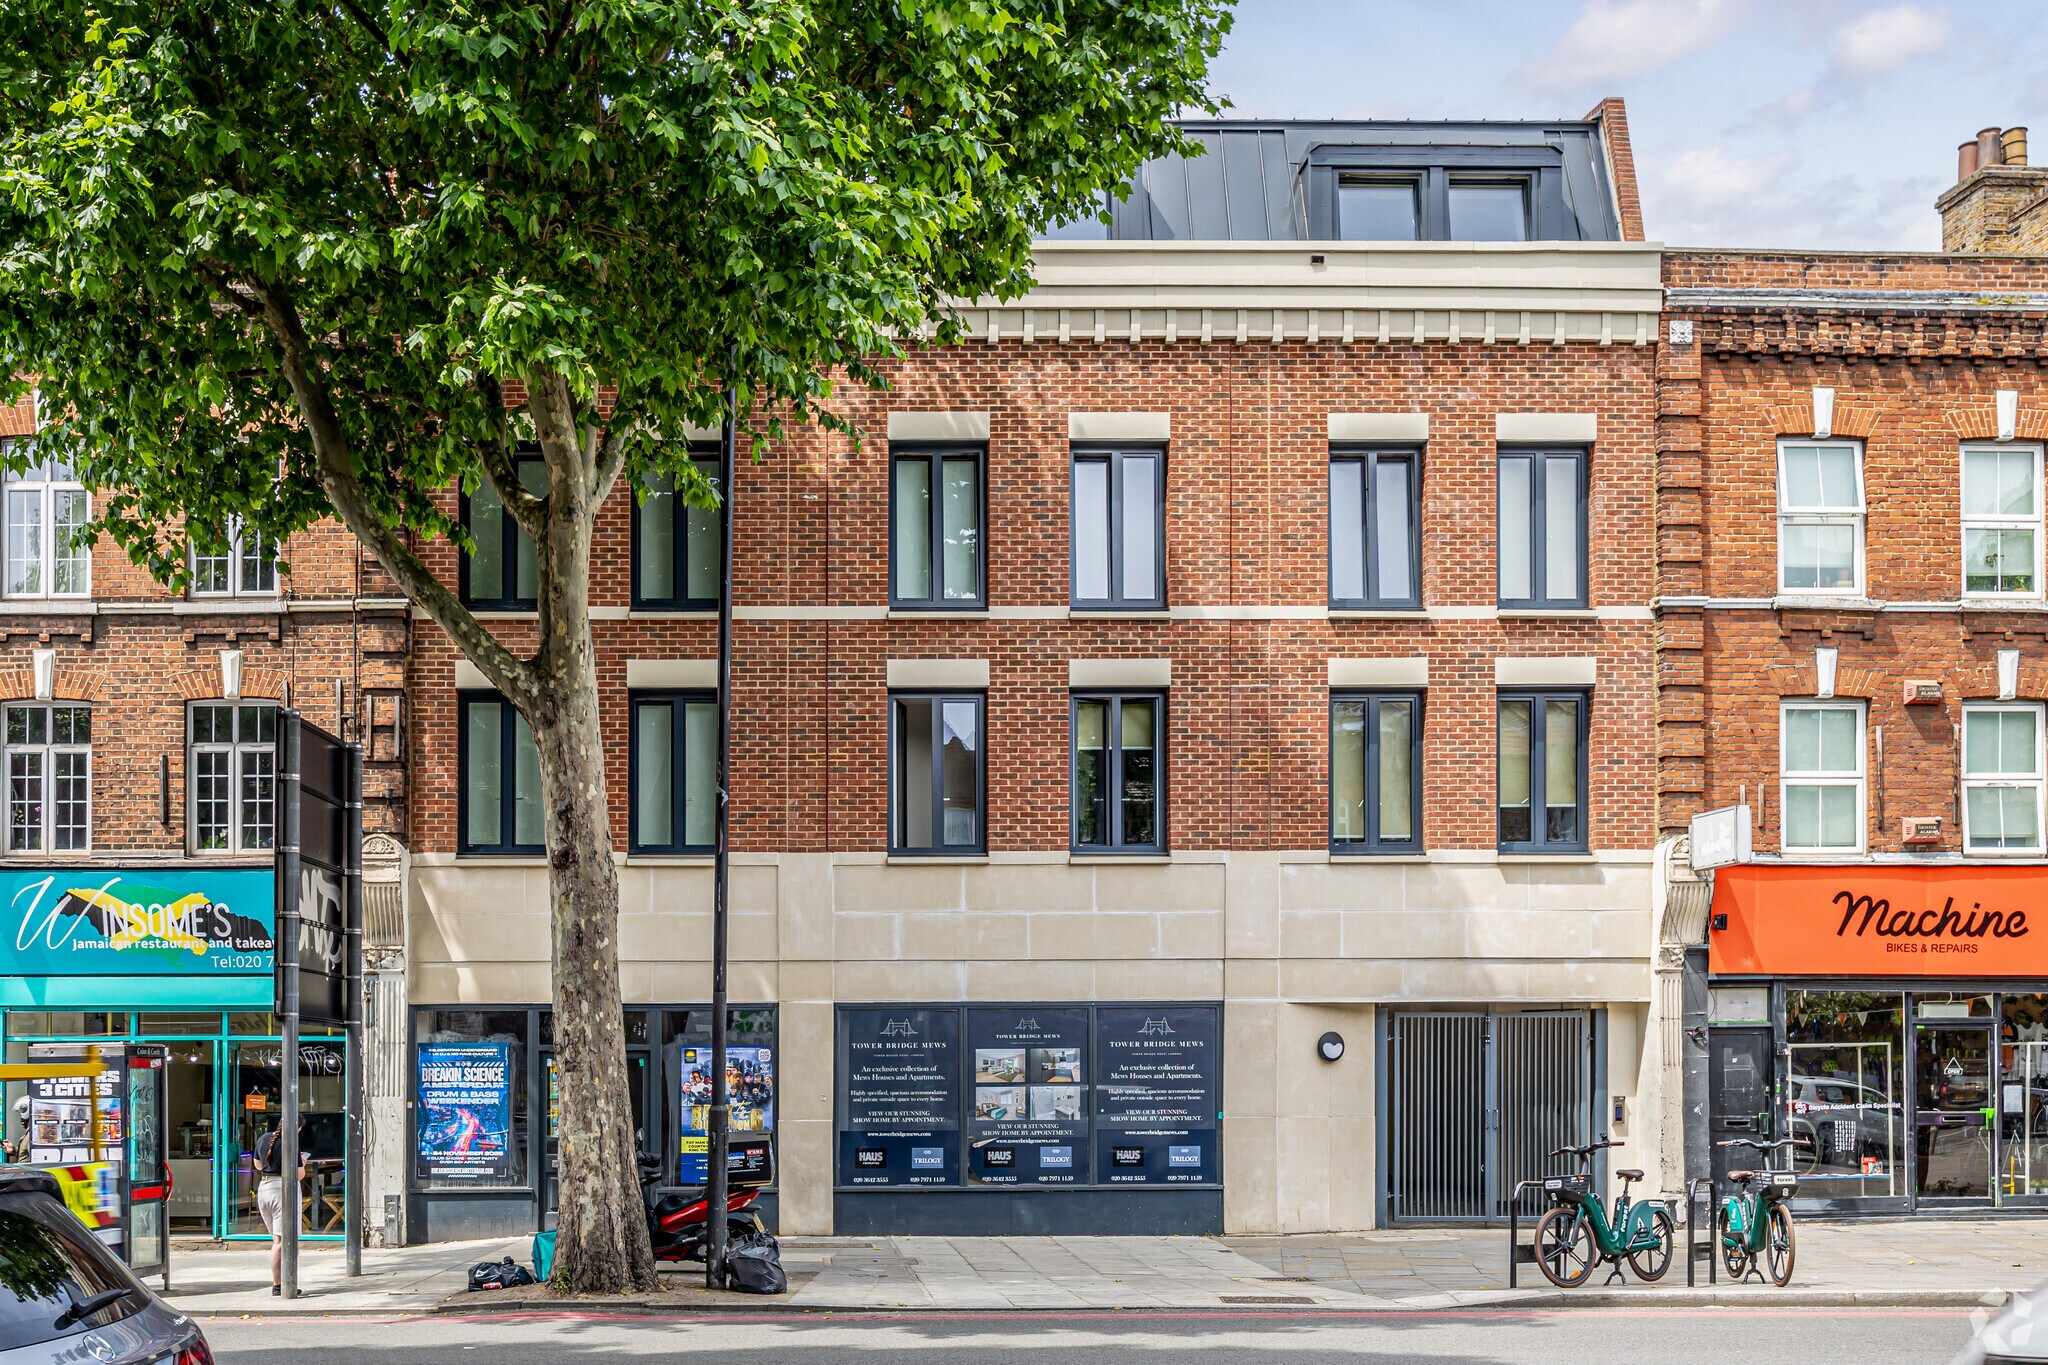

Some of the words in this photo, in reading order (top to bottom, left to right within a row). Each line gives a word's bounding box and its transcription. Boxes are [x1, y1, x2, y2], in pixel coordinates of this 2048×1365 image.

[1832, 891, 2029, 938] Machine
[72, 938, 131, 951] Jamaican
[135, 938, 205, 949] restaurant
[209, 936, 232, 948] and
[236, 936, 274, 948] takea
[1887, 944, 1918, 953] BIKES
[1921, 944, 1928, 953] &
[1931, 944, 1978, 953] REPAIRS
[211, 956, 262, 968] Tel:020
[422, 1068, 461, 1082] BREAKIN
[464, 1068, 504, 1082] SCIENCE
[909, 1074, 945, 1082] Apartments.
[40, 1084, 52, 1096] 3
[750, 1109, 764, 1130] 6
[859, 1152, 883, 1161] HAUS
[988, 1151, 1012, 1160] HAUS
[1117, 1151, 1140, 1160] HAUS
[1620, 1205, 1629, 1232] forest
